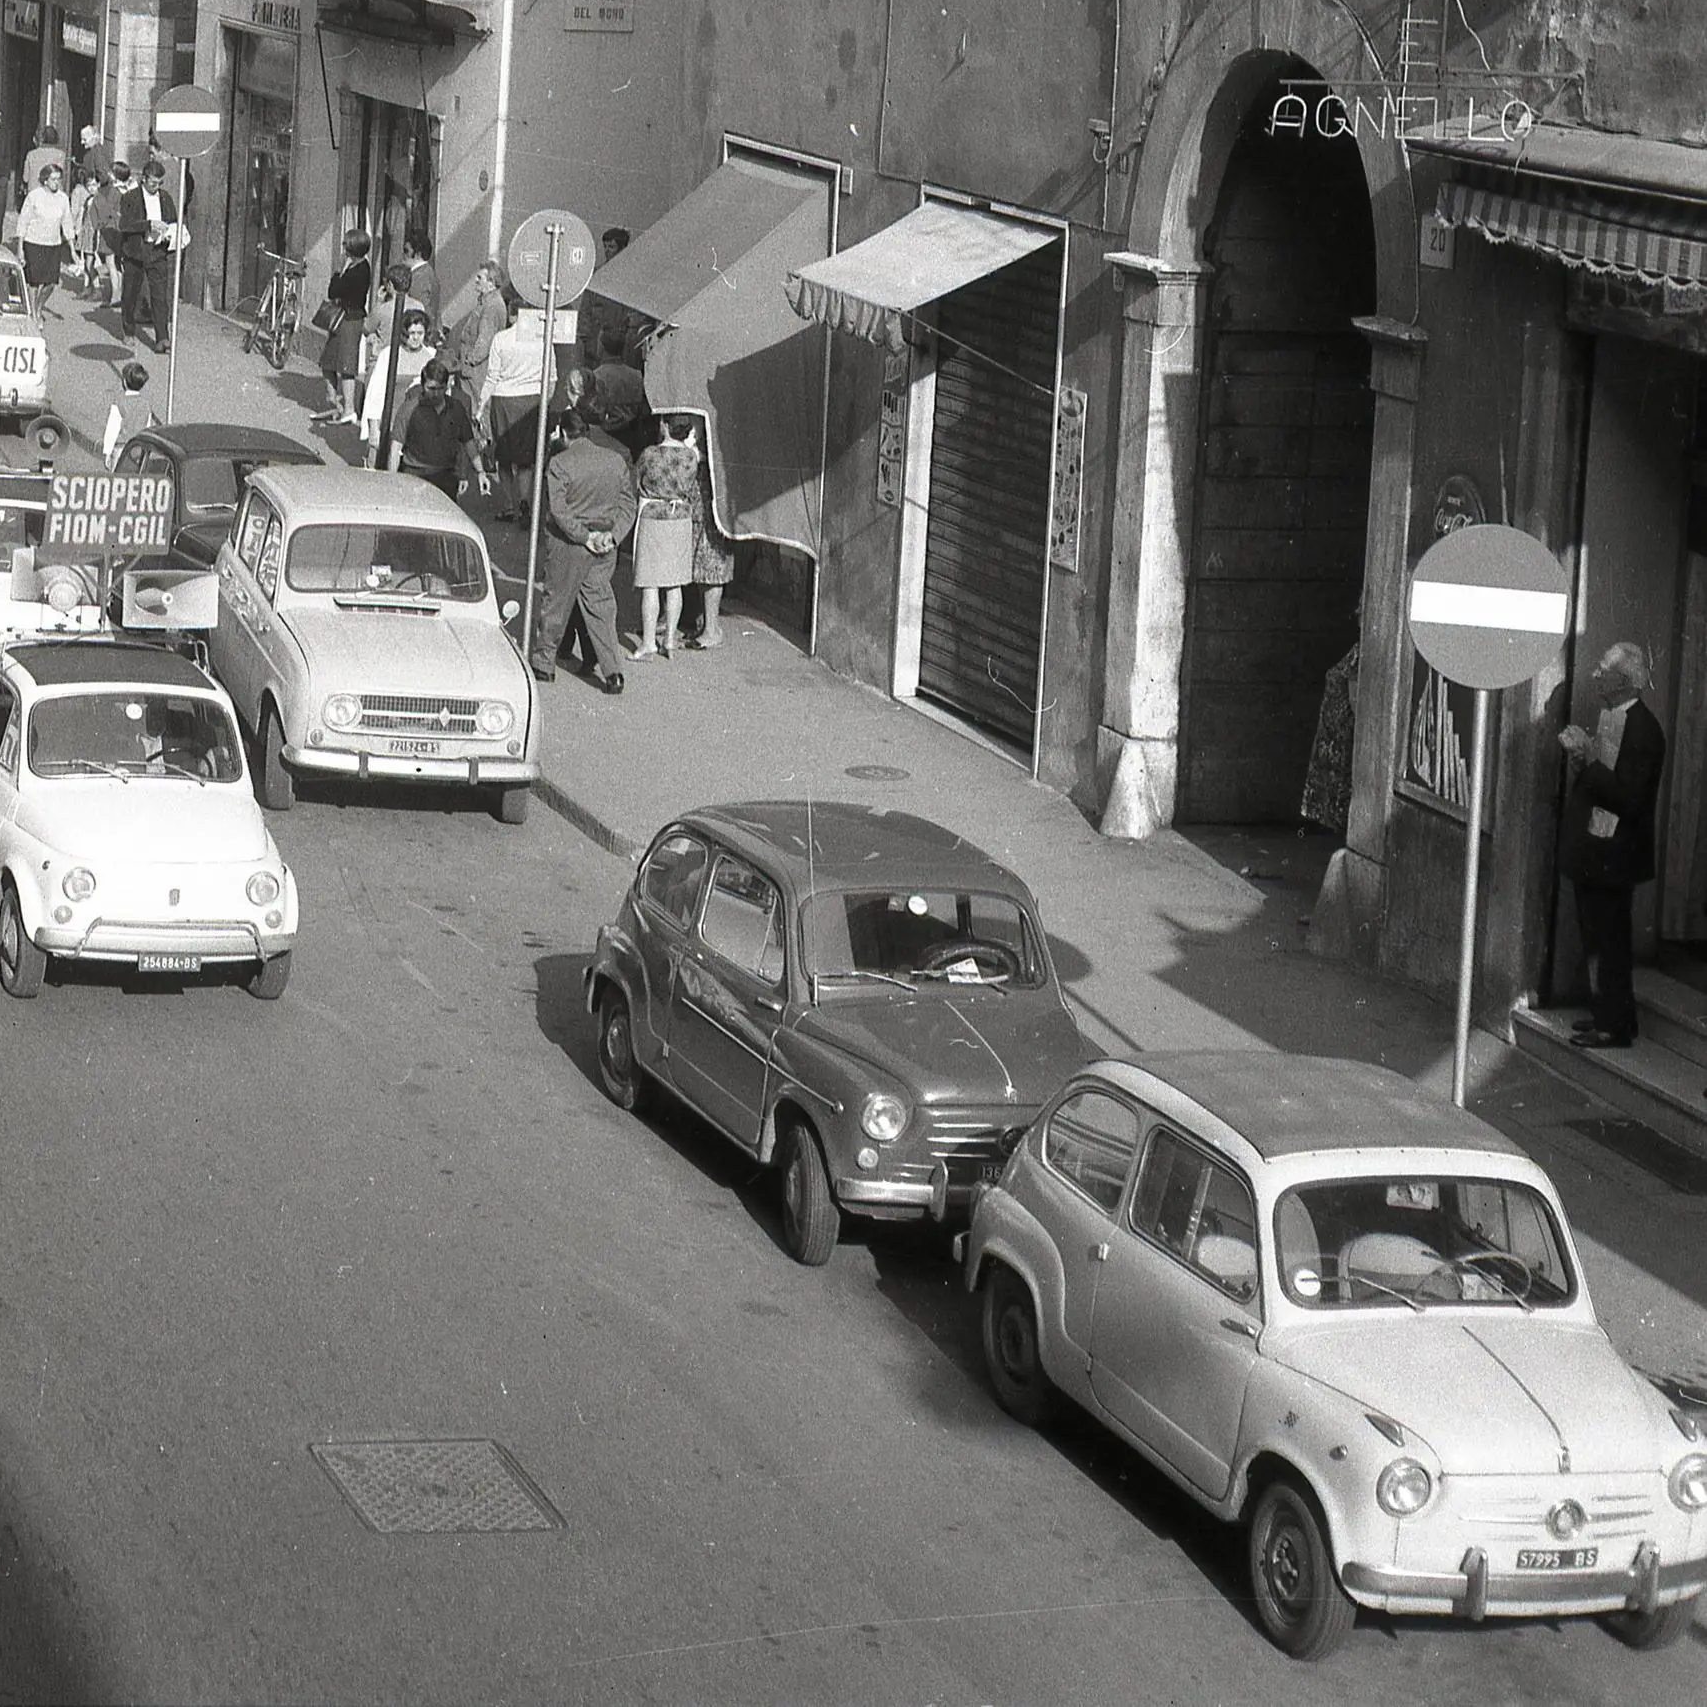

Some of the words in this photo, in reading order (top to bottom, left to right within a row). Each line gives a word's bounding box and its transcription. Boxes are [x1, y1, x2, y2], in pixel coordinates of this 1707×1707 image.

[574, 7, 591, 19] DEL
[1266, 93, 1533, 142] AGNELLO
[1429, 229, 1447, 253] 20
[50, 475, 171, 513] SCIOPERO
[48, 511, 167, 546] FIOM-CGIL
[1575, 1549, 1597, 1566] BS
